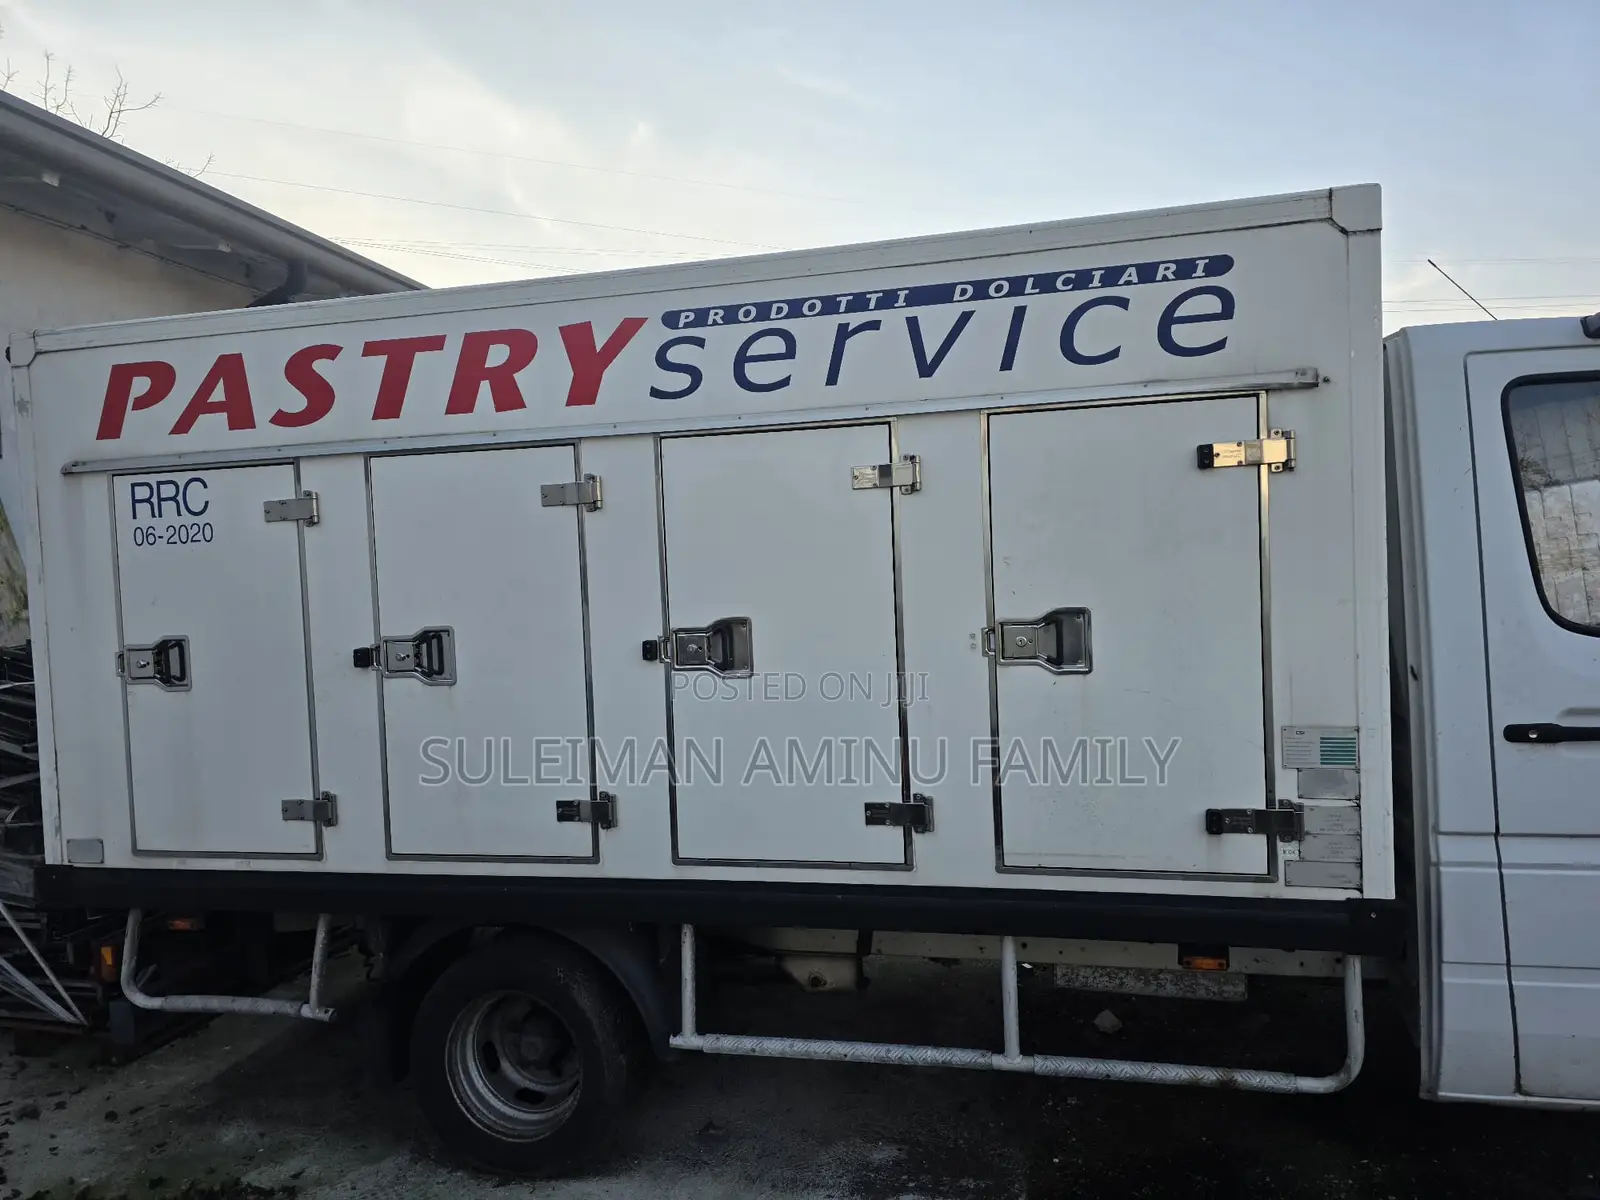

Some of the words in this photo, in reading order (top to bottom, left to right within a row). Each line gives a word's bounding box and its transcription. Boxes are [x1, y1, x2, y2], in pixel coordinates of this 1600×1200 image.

[678, 289, 910, 328] PRODOTTI
[953, 257, 1211, 302] DOLCIARI
[98, 318, 646, 441] PASTRY
[649, 285, 1236, 400] service
[130, 476, 210, 520] RRC
[133, 522, 214, 547] 06-2020
